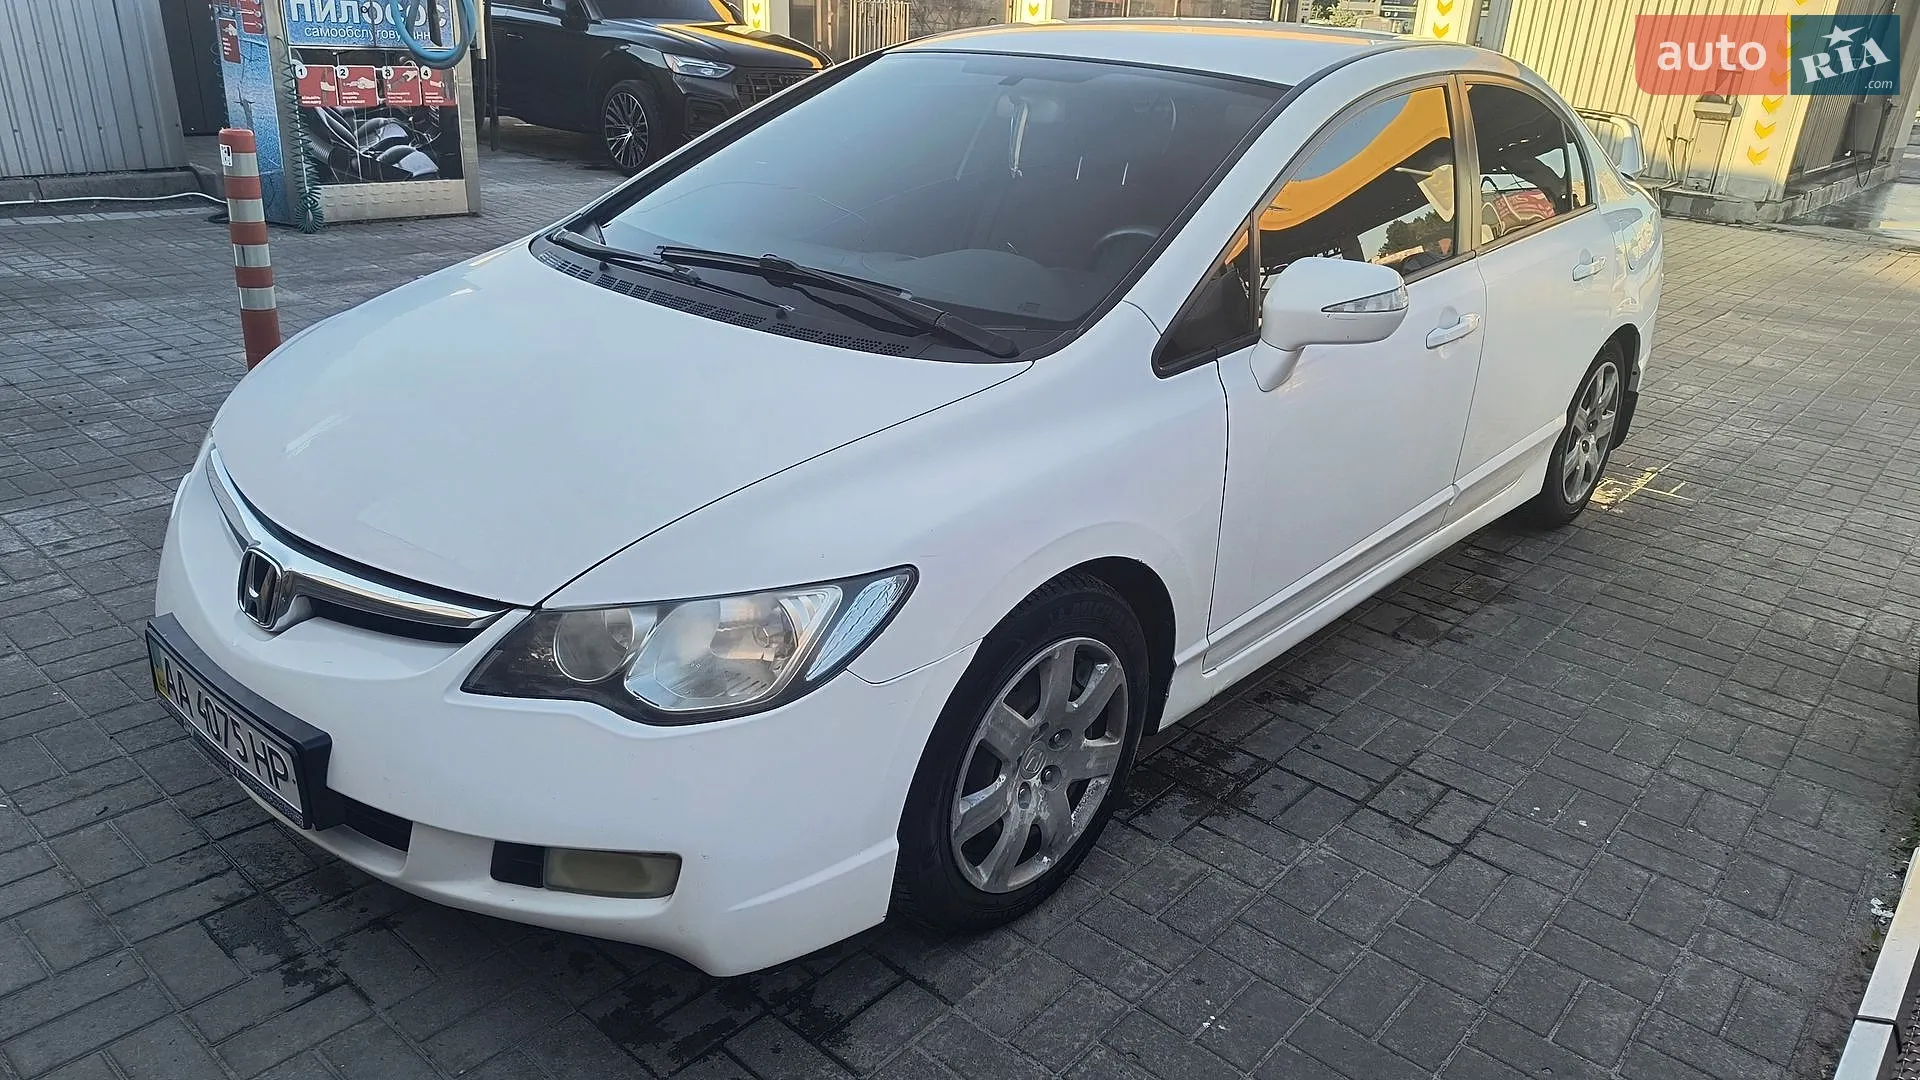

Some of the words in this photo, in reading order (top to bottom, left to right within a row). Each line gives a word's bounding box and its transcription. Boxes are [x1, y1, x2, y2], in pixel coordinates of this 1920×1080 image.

[164, 656, 194, 718] AA
[197, 688, 248, 763] 4075
[249, 730, 289, 790] HP
